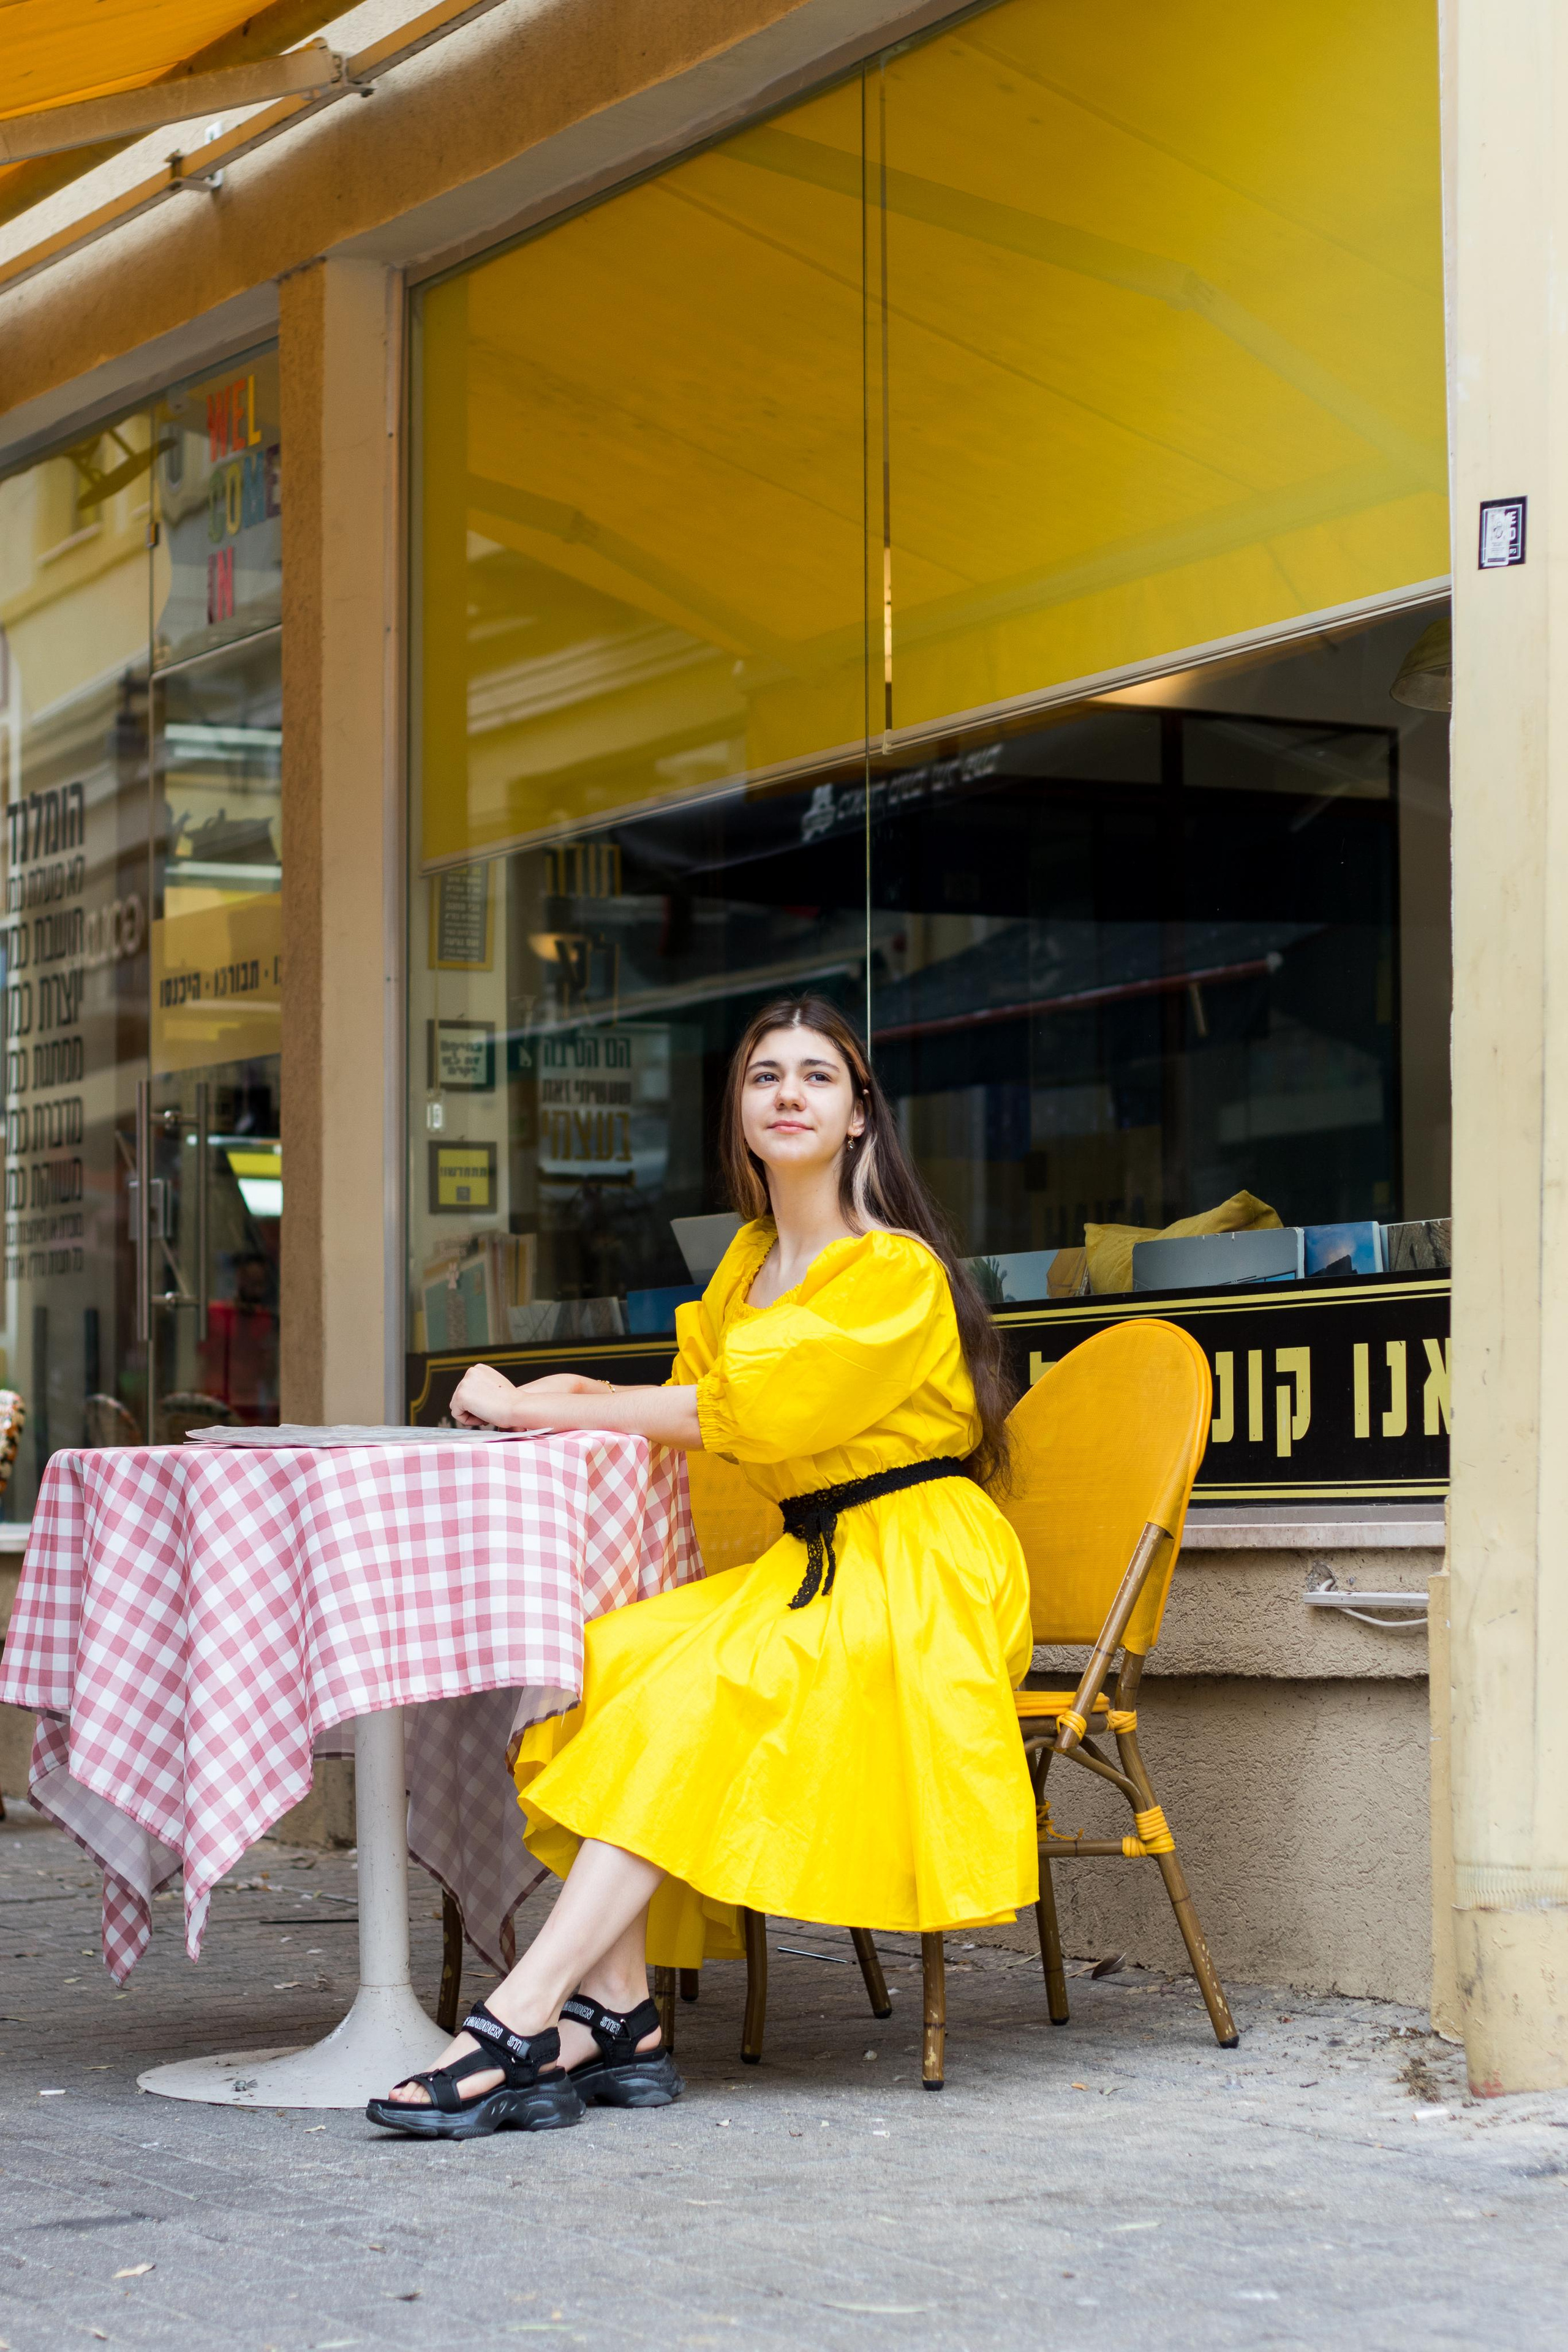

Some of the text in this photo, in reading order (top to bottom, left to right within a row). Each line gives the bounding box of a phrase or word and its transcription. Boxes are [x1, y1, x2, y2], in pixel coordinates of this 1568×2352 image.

[206, 374, 262, 462] WEL
[207, 545, 233, 625] IN
[1212, 1346, 1311, 1457] קונ
